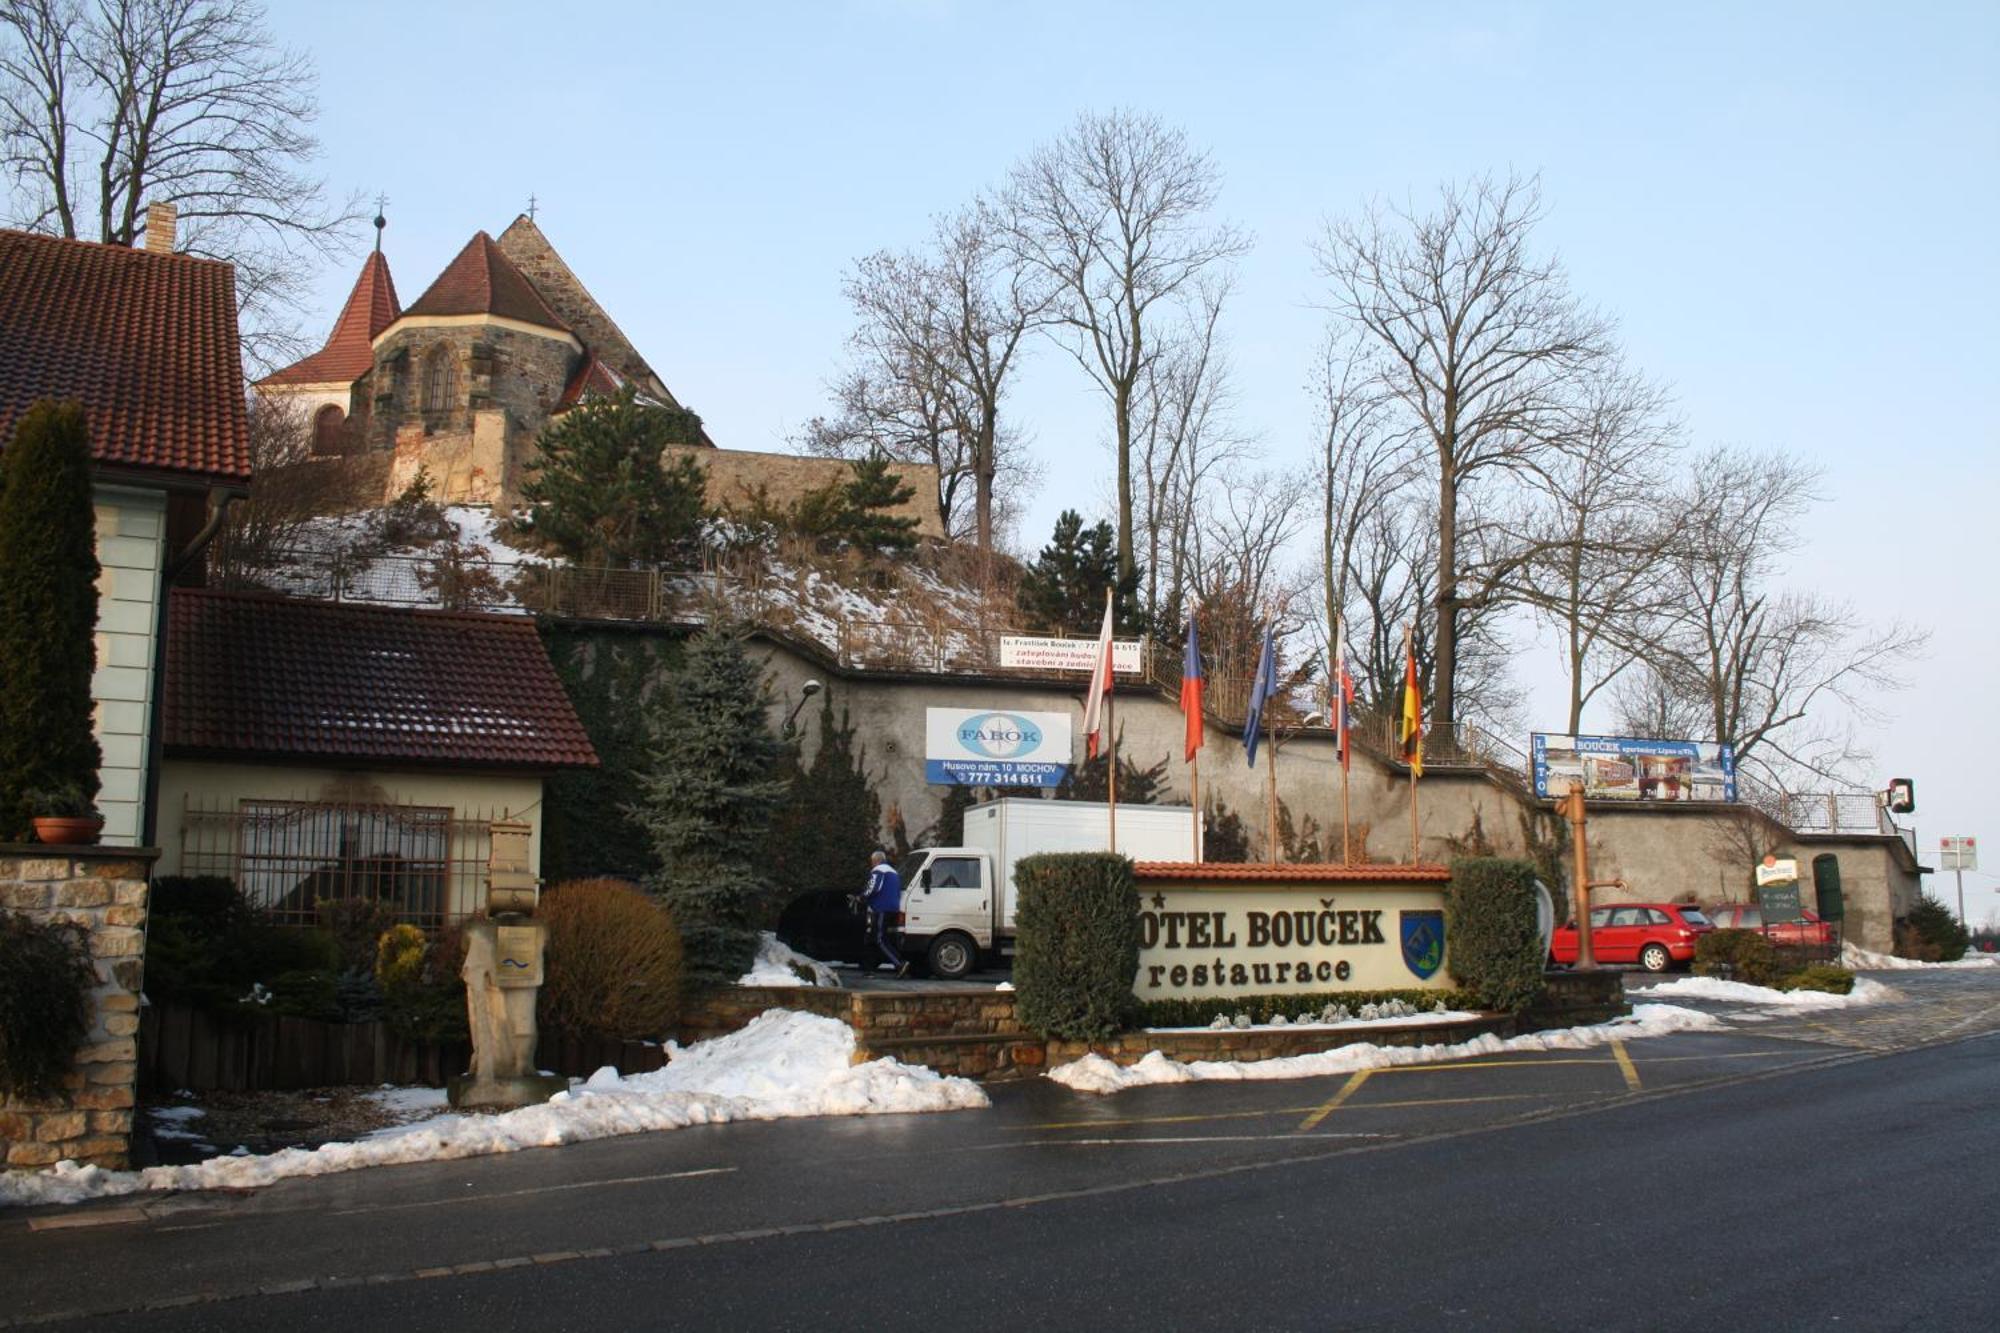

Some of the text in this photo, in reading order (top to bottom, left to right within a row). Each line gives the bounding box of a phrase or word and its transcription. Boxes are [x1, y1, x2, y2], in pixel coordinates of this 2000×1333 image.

[943, 761, 1056, 773] Husovo nám. 10 MOCHOV
[968, 772, 1042, 784] 777 314 611
[1723, 748, 1733, 797] ZIMA
[1138, 898, 1385, 949] OTEL BOUČEK
[1148, 957, 1350, 988] restaurace
